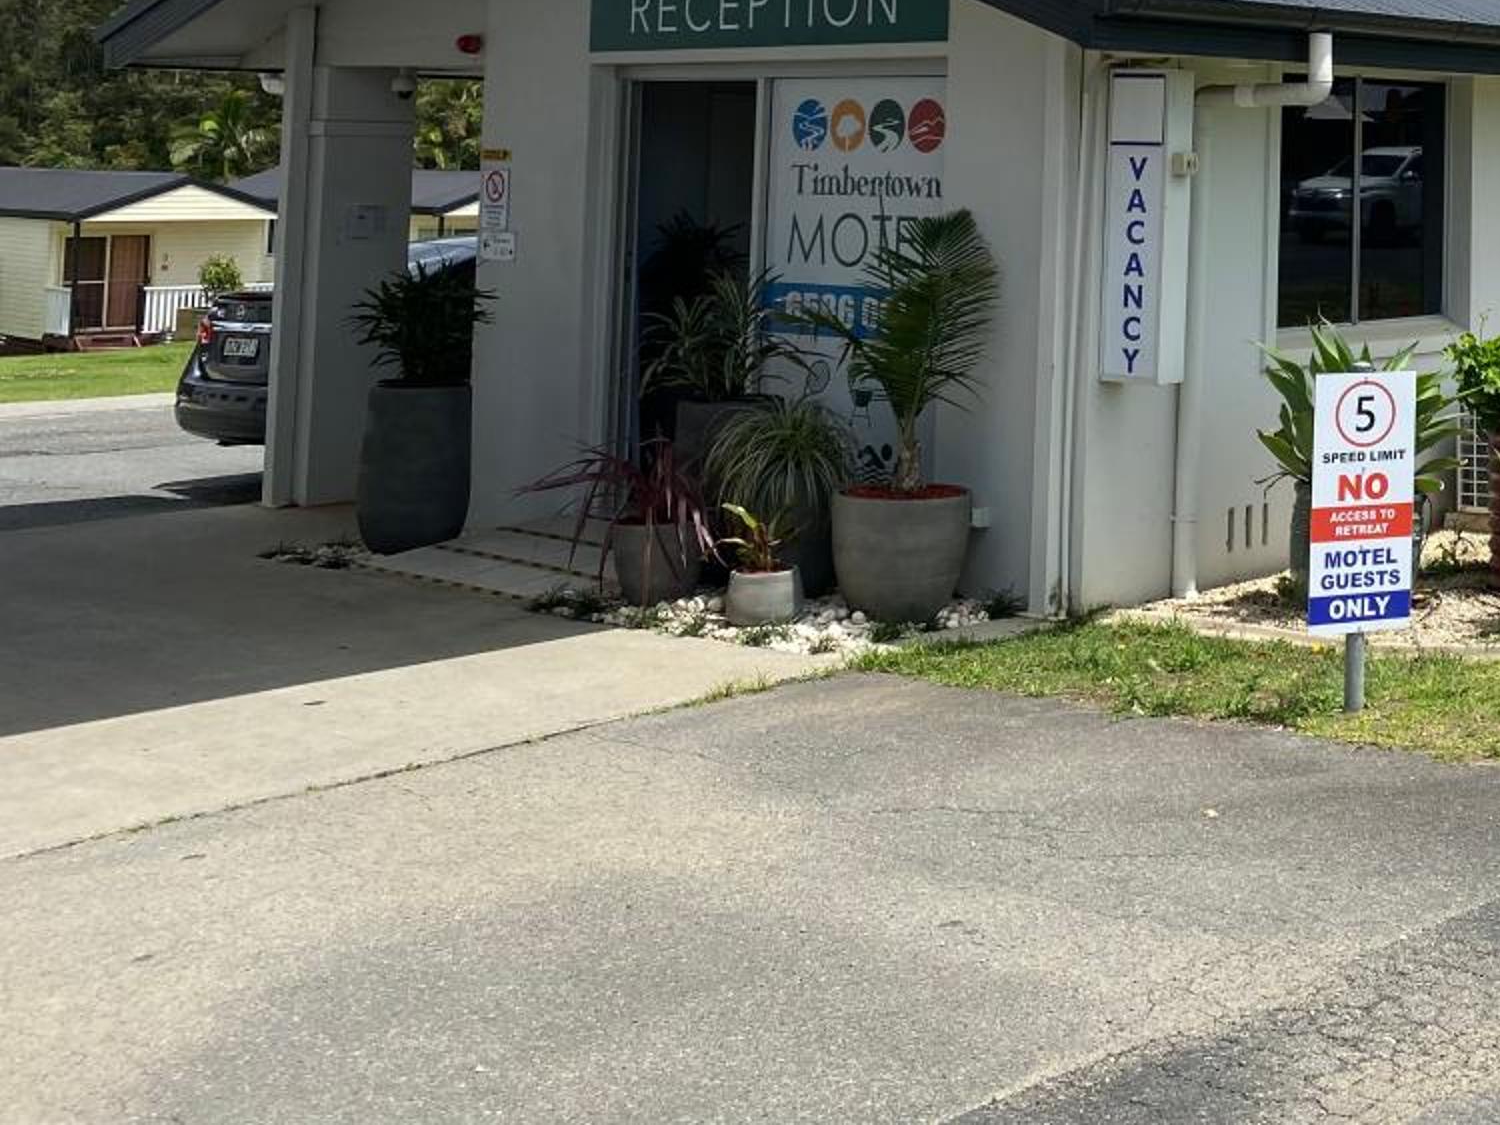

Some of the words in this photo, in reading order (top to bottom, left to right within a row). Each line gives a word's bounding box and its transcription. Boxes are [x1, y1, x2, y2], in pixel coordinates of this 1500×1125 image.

[792, 163, 942, 199] Timbertown
[1122, 156, 1148, 374] VACANCY
[1355, 396, 1376, 433] 5
[1322, 451, 1365, 464] SPEED
[1370, 449, 1406, 462] LIMIT
[1337, 472, 1389, 501] NO
[1329, 510, 1377, 523] ACCESS
[1380, 508, 1396, 520] TO
[1335, 523, 1389, 536] RETREAT
[1324, 548, 1398, 569] MOTEL
[1320, 569, 1401, 590] GUESTS
[1328, 596, 1391, 619] ONLY
